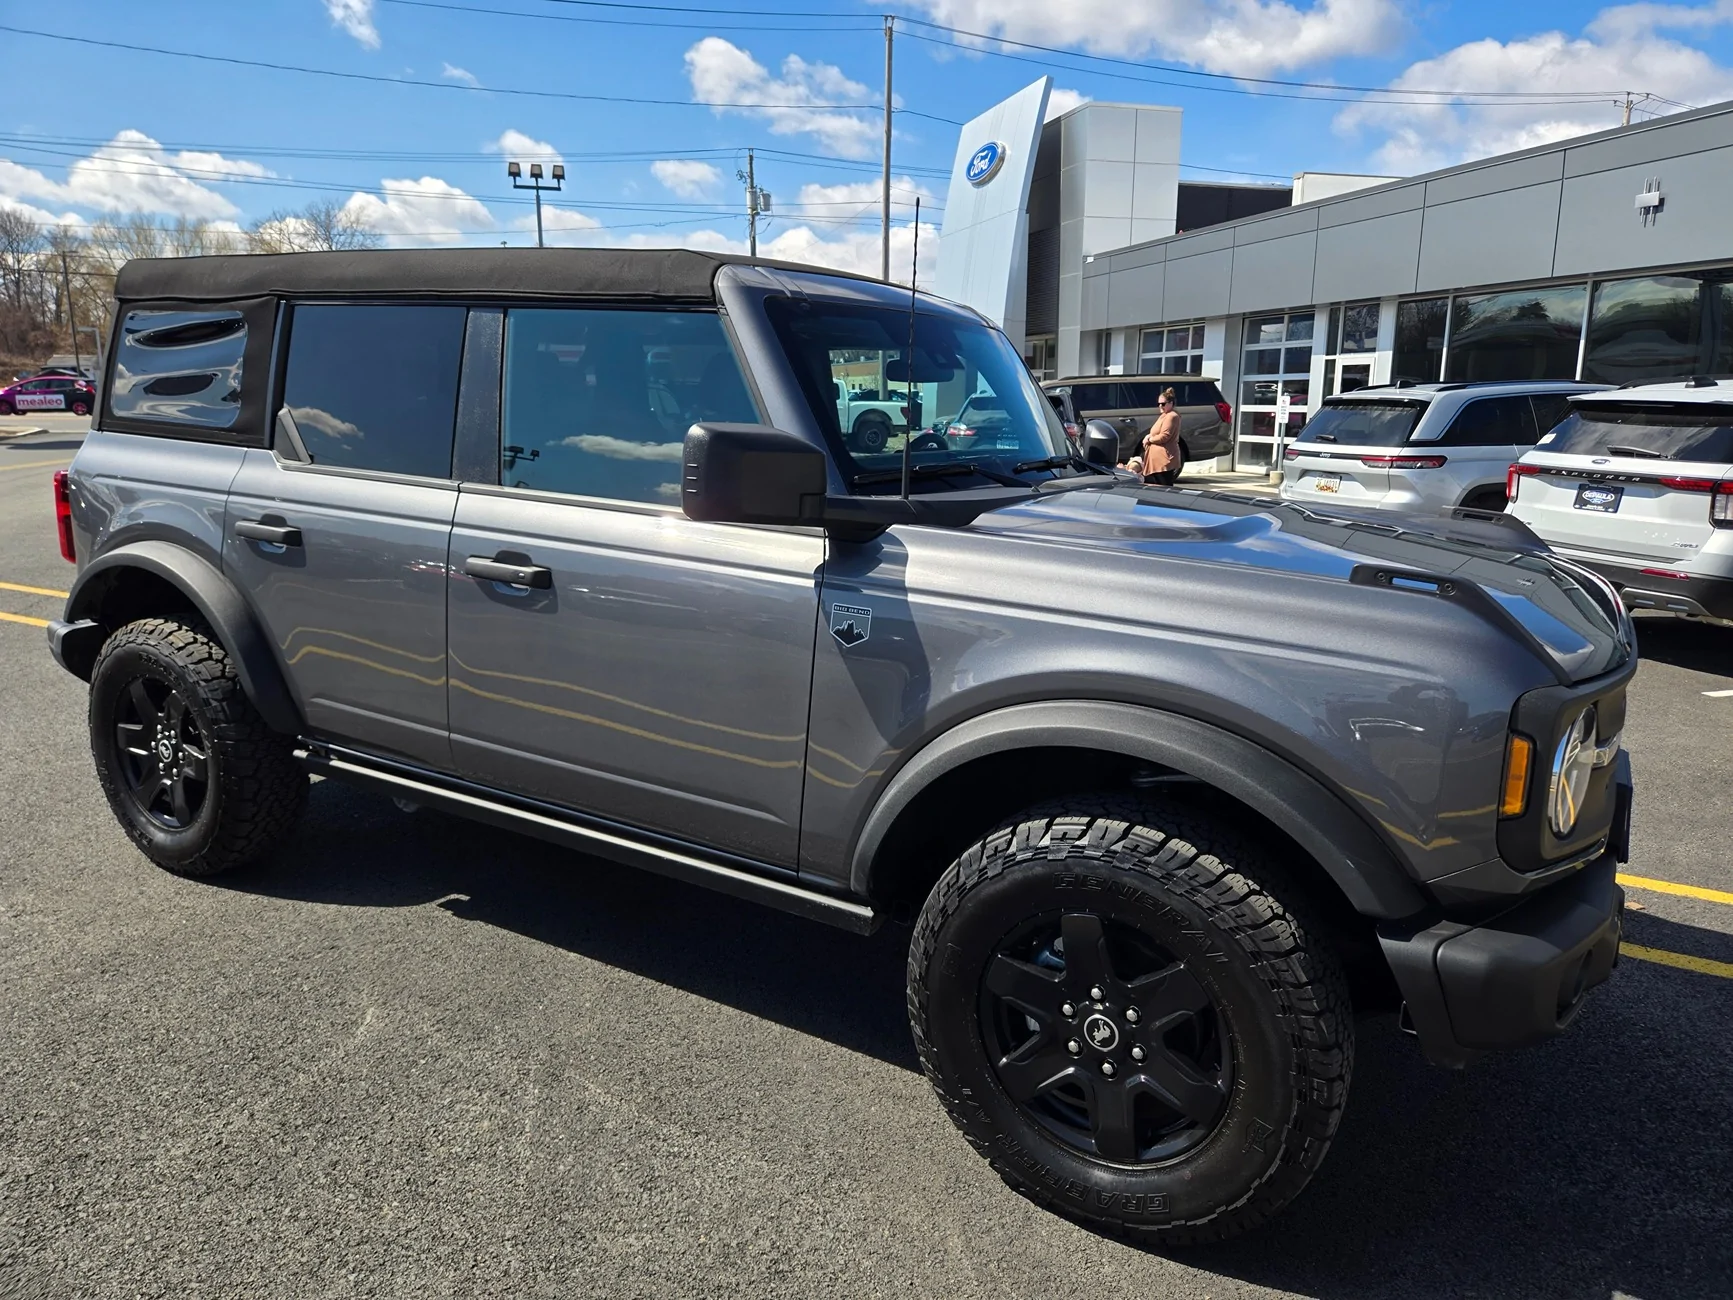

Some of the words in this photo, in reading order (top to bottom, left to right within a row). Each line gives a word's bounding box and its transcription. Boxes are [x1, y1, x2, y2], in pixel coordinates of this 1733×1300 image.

[970, 150, 992, 177] Ford
[17, 396, 63, 406] mealeo
[1550, 469, 1641, 482] EXPLORER
[1053, 871, 1229, 963] GENERAL
[995, 1130, 1171, 1215] GRABBER
